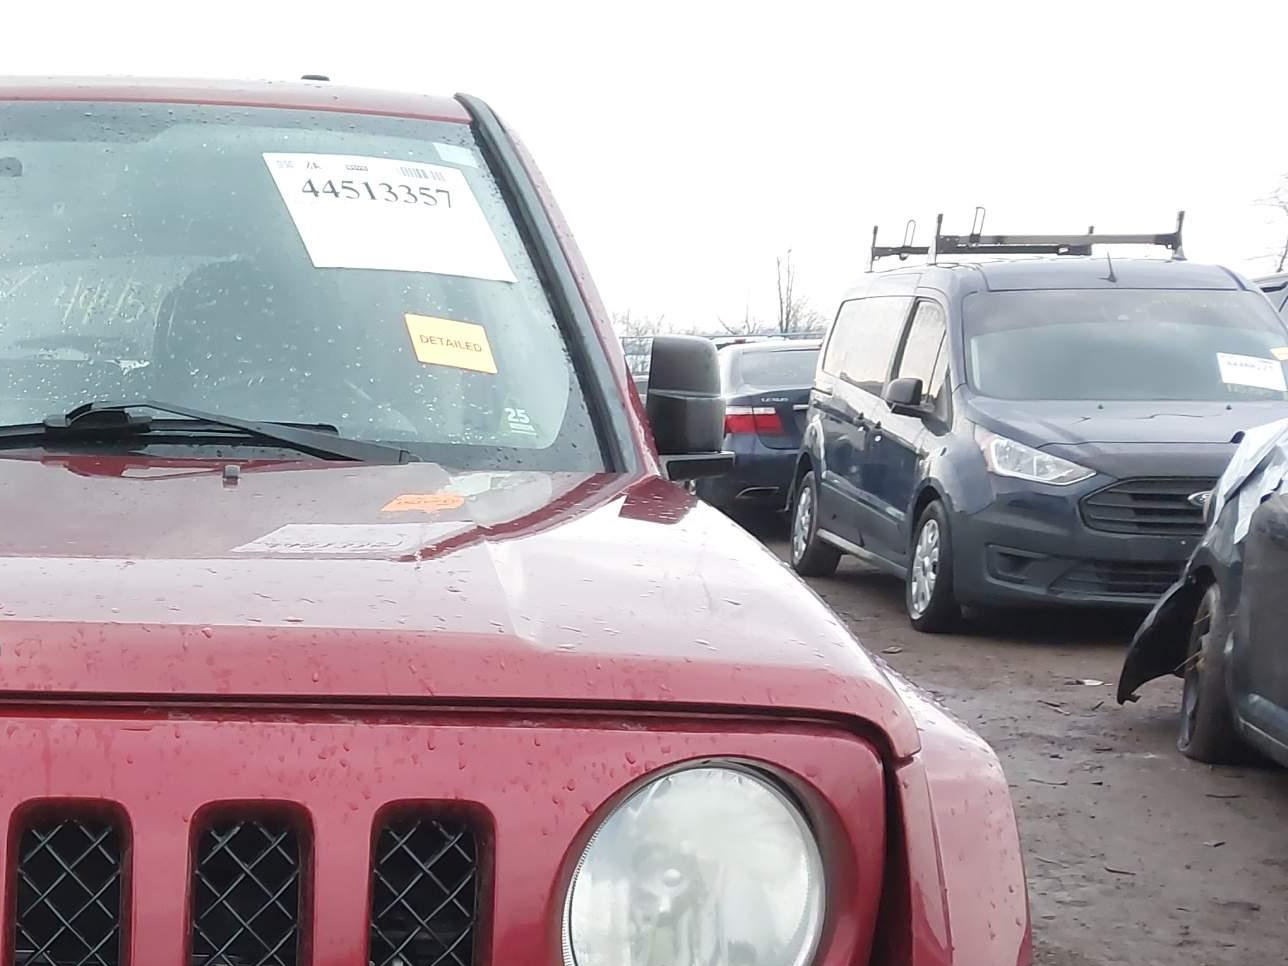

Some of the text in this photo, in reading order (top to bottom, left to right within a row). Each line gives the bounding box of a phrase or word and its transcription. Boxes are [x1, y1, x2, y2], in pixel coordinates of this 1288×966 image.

[301, 177, 452, 209] 44513357
[419, 334, 482, 352] DETAILED
[504, 407, 530, 424] 25
